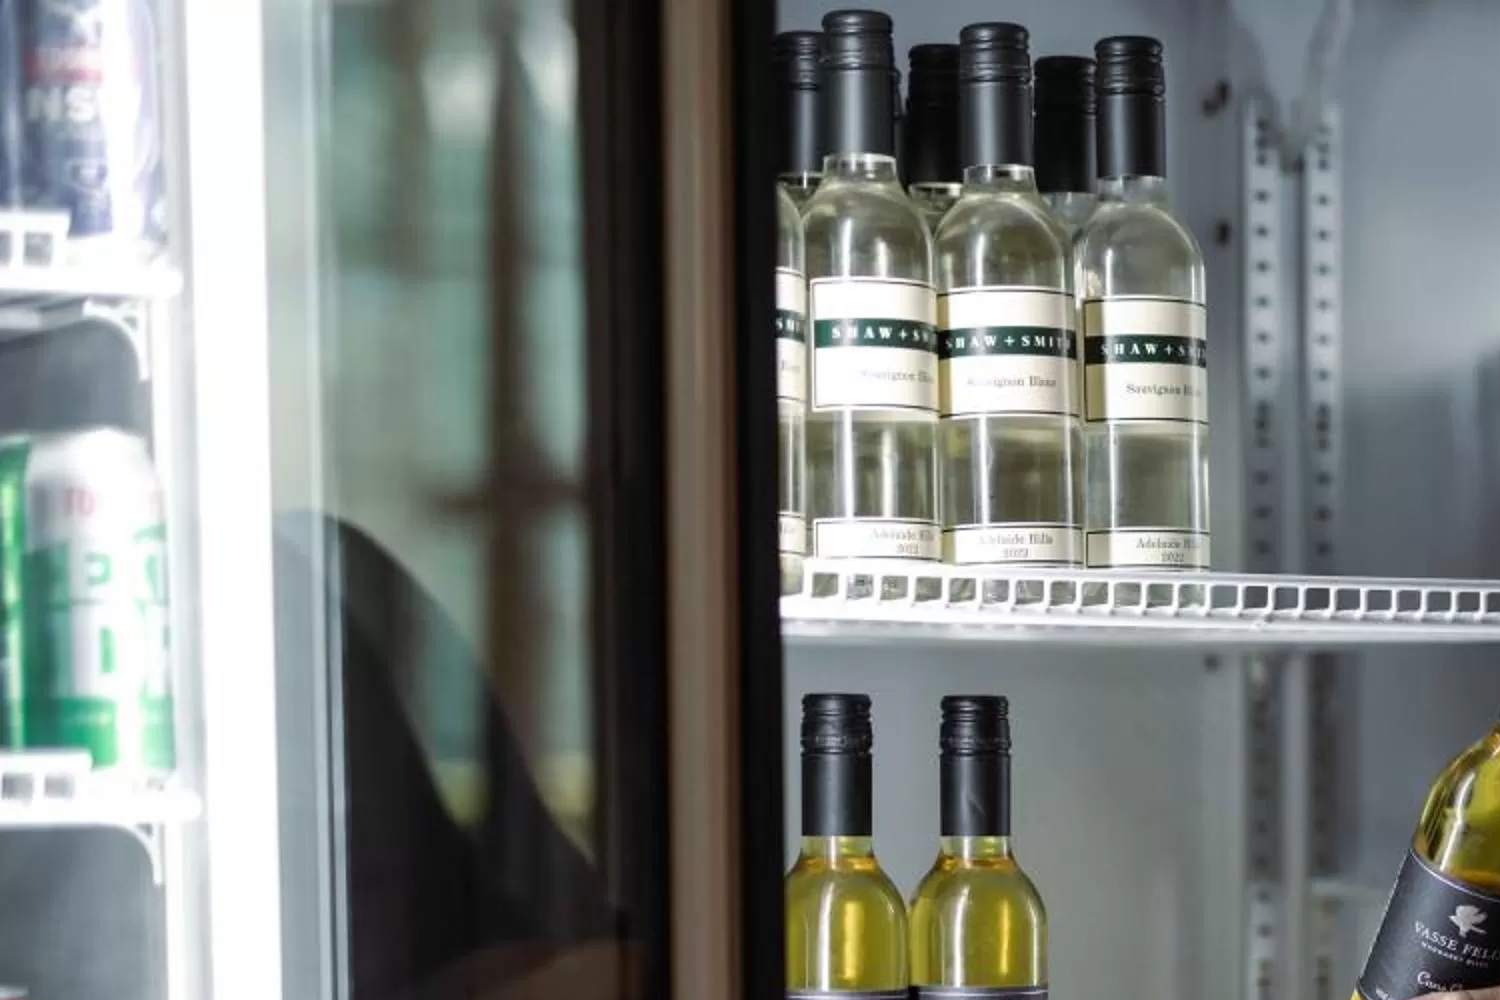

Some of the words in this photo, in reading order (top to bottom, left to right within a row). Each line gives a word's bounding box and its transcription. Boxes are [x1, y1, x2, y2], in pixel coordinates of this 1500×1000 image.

[832, 325, 892, 339] SHAW
[946, 335, 997, 348] SHAW
[1101, 343, 1158, 355] SHAW
[1415, 920, 1458, 951] VASSE
